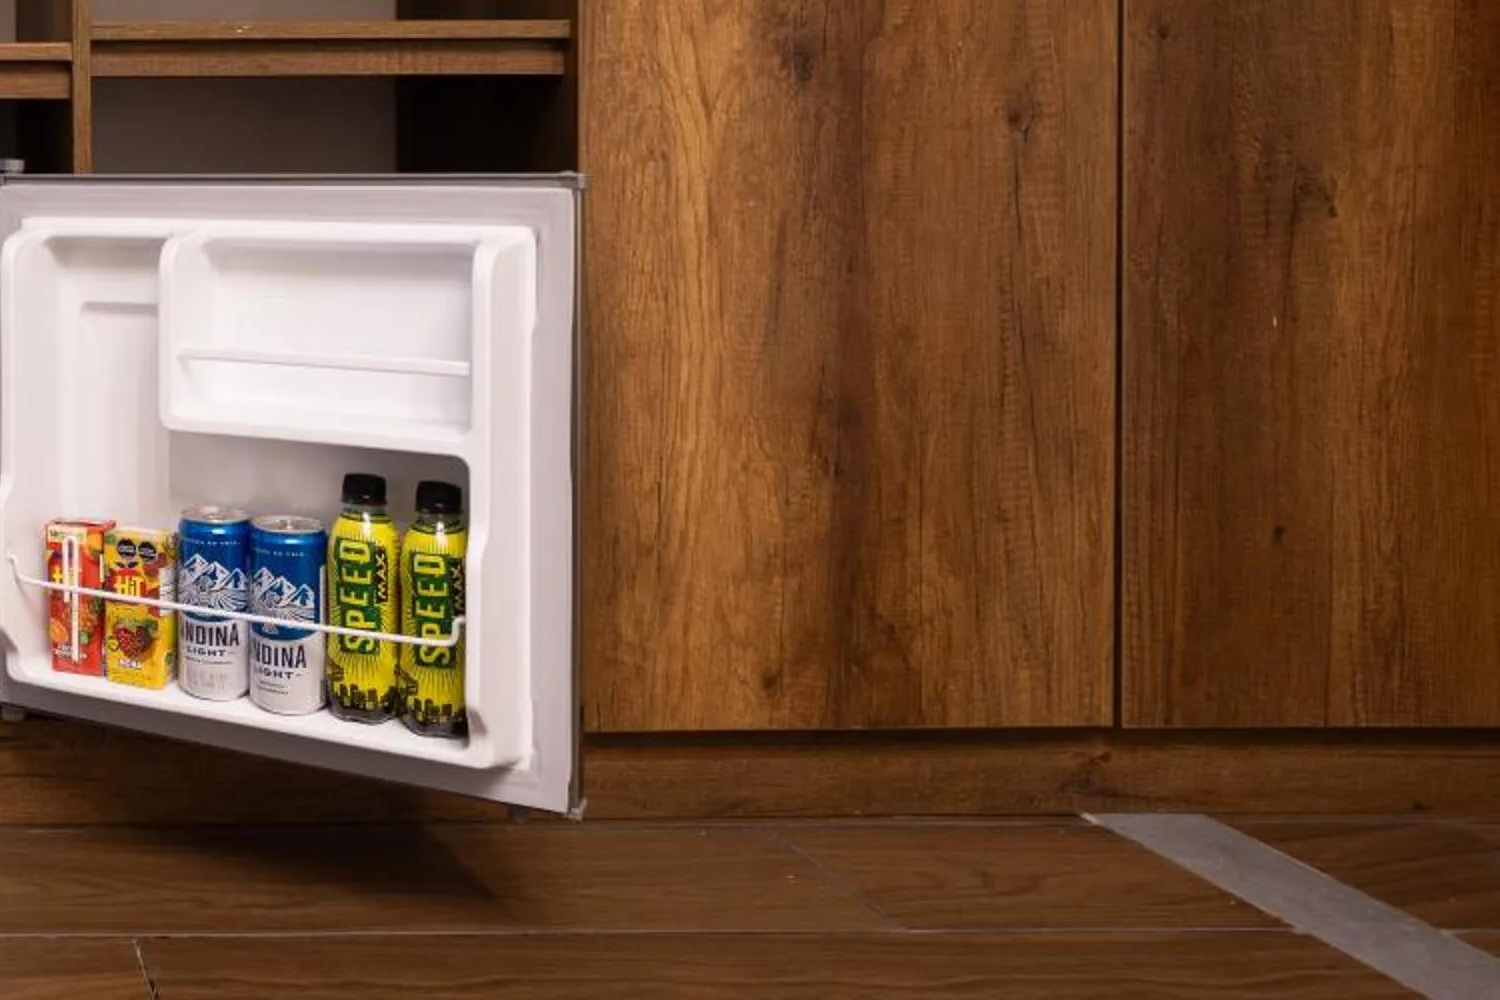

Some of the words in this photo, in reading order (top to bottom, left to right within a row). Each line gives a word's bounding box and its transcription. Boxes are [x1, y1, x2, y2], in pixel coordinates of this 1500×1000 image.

[339, 540, 376, 652] SPEED
[375, 552, 387, 600] MAX
[413, 553, 451, 665] SPEED
[181, 619, 240, 646] NDINA
[253, 638, 307, 668] NDINA
